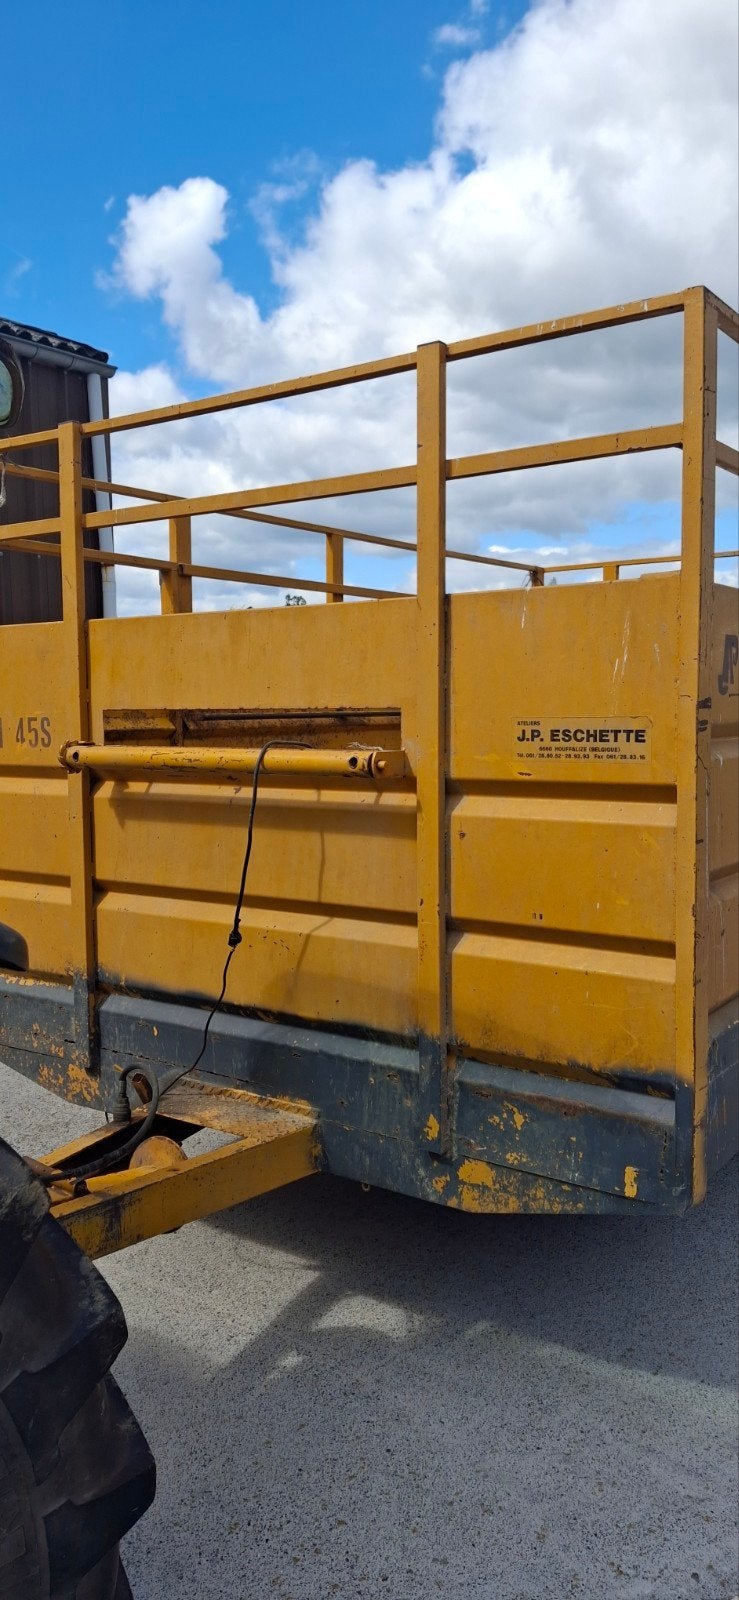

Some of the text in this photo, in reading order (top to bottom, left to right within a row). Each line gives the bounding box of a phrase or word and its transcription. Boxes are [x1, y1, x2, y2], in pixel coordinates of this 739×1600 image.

[16, 717, 51, 748] 45S
[517, 729, 646, 743] J.P. ESCHETTE
